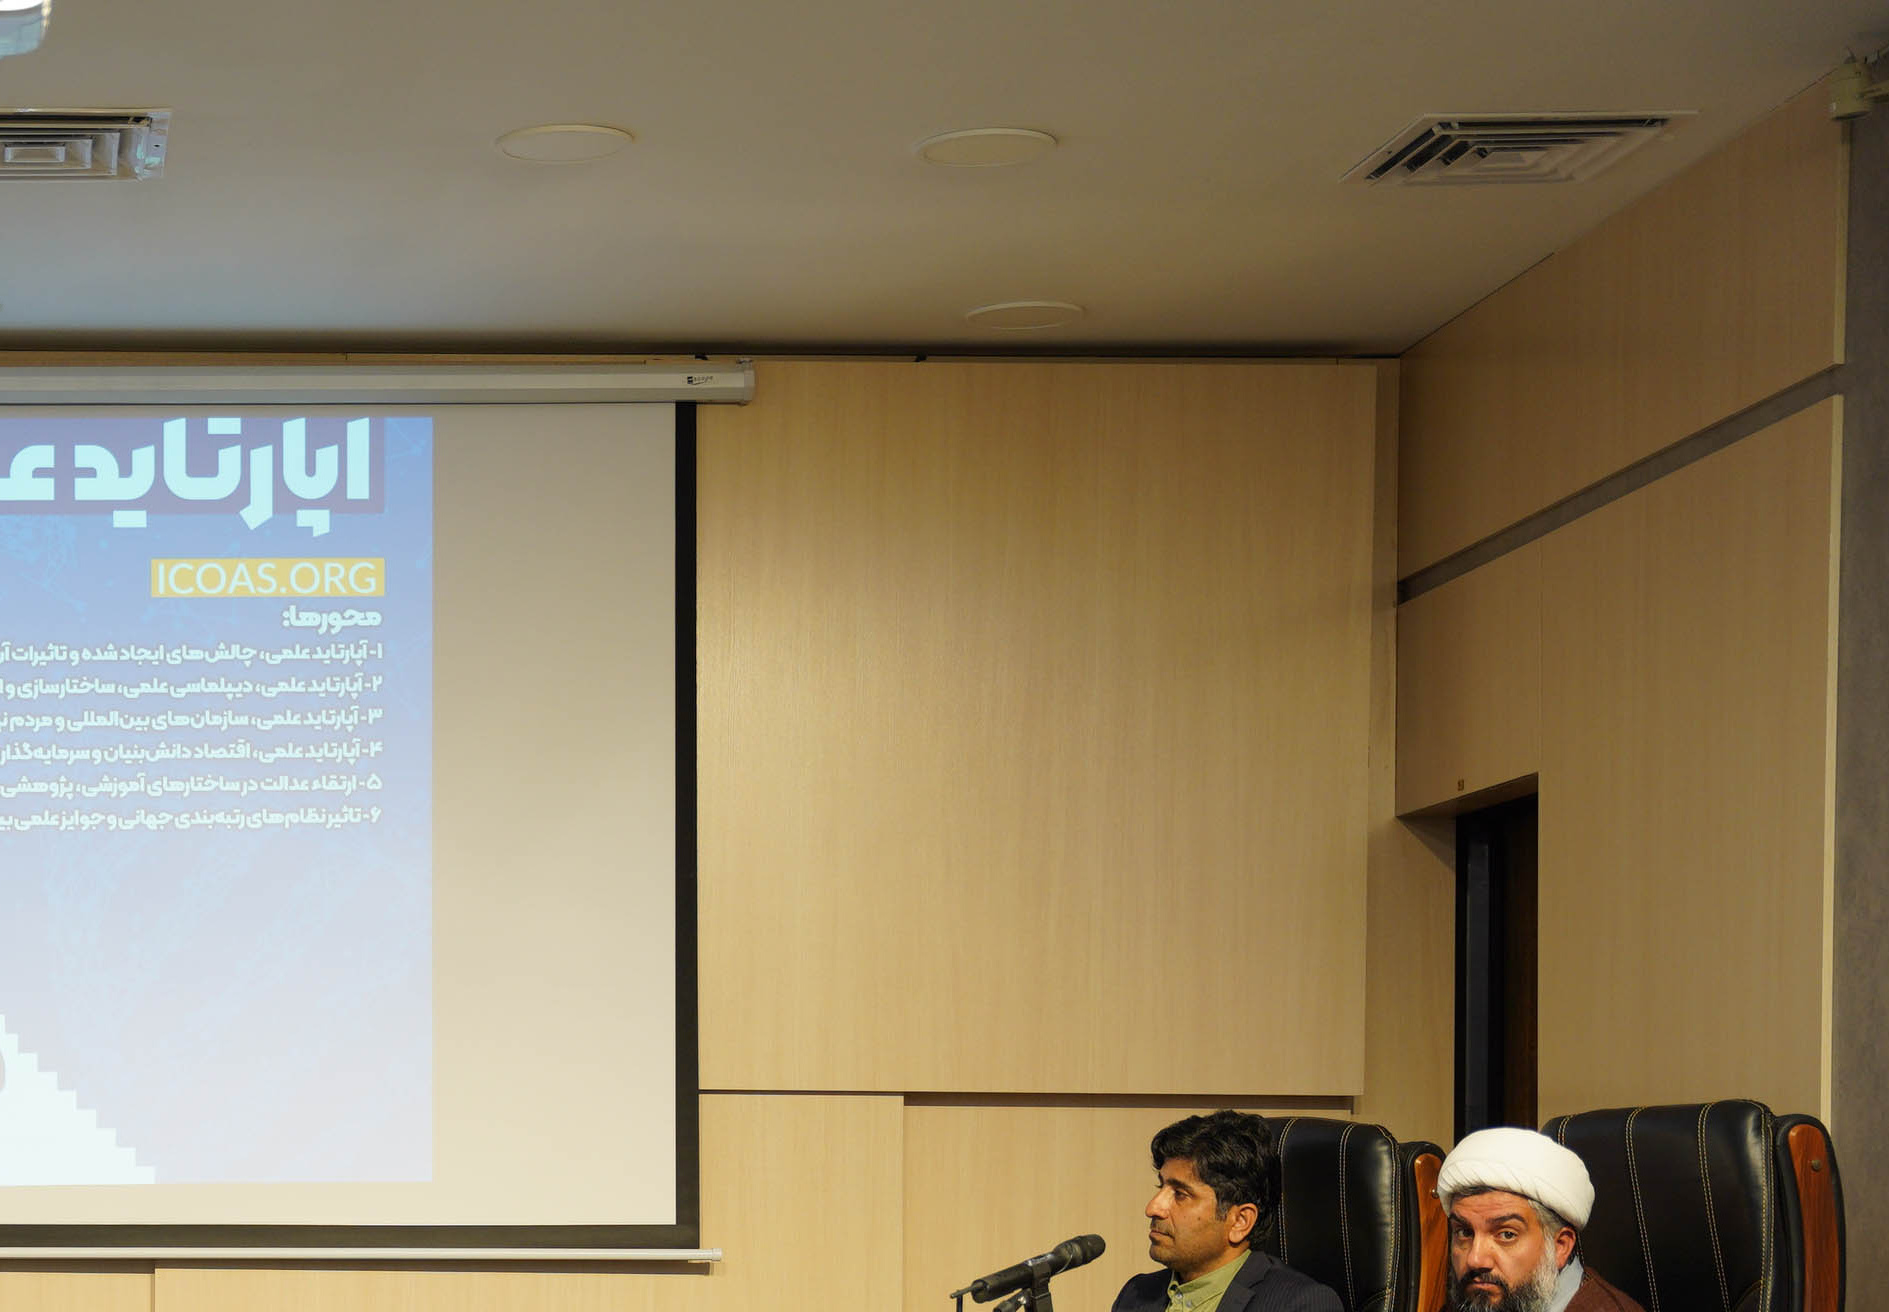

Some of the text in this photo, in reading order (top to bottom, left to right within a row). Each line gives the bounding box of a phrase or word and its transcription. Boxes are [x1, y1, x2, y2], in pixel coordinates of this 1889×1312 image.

[157, 562, 376, 595] ICOAS.ORG
[282, 605, 382, 634] محورها:
[70, 650, 80, 666] و
[8, 684, 16, 700] و
[54, 717, 64, 732] و
[92, 750, 101, 764] و
[107, 815, 116, 830] و
